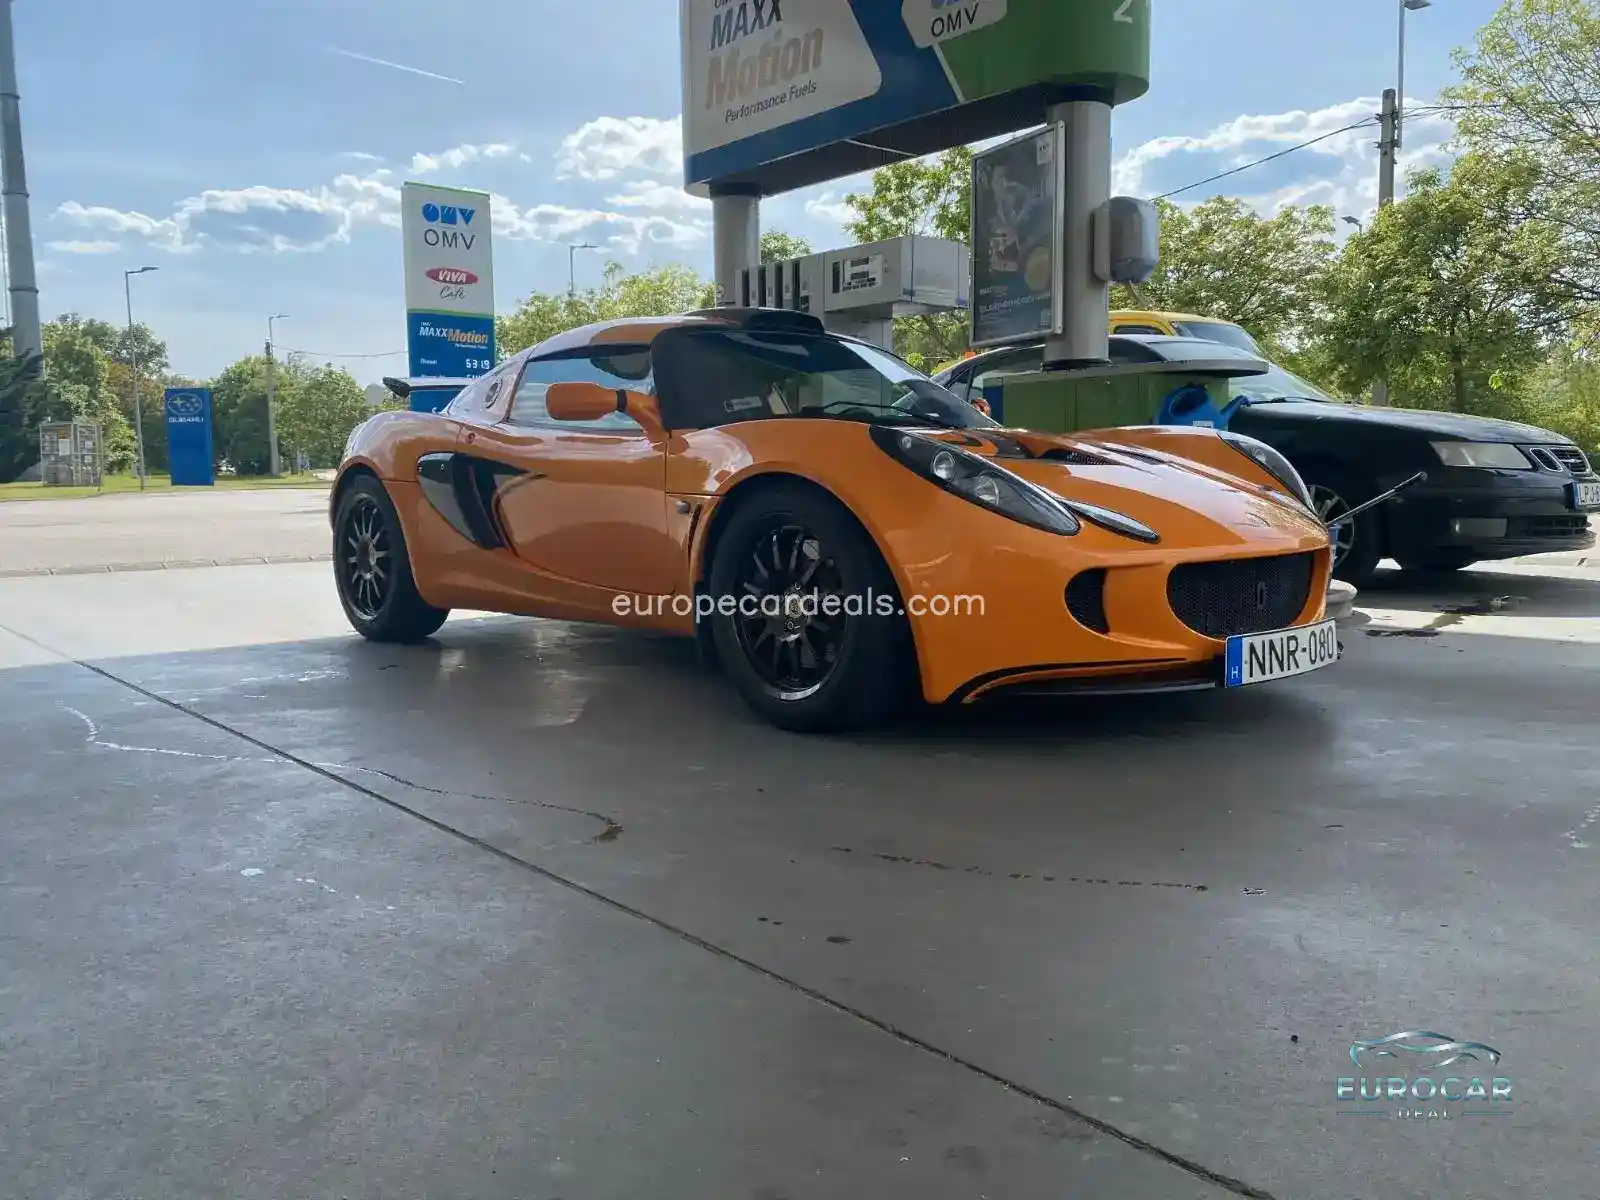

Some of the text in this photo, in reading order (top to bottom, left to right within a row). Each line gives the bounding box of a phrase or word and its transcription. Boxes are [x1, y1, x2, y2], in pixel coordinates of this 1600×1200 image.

[709, 0, 782, 51] MAXX
[931, 2, 979, 37] OMV
[706, 28, 824, 109] Motion
[725, 79, 817, 122] Performance Fuels
[424, 229, 476, 250] OMV
[438, 269, 466, 283] VIVA
[1231, 625, 1335, 679] H NNR-080
